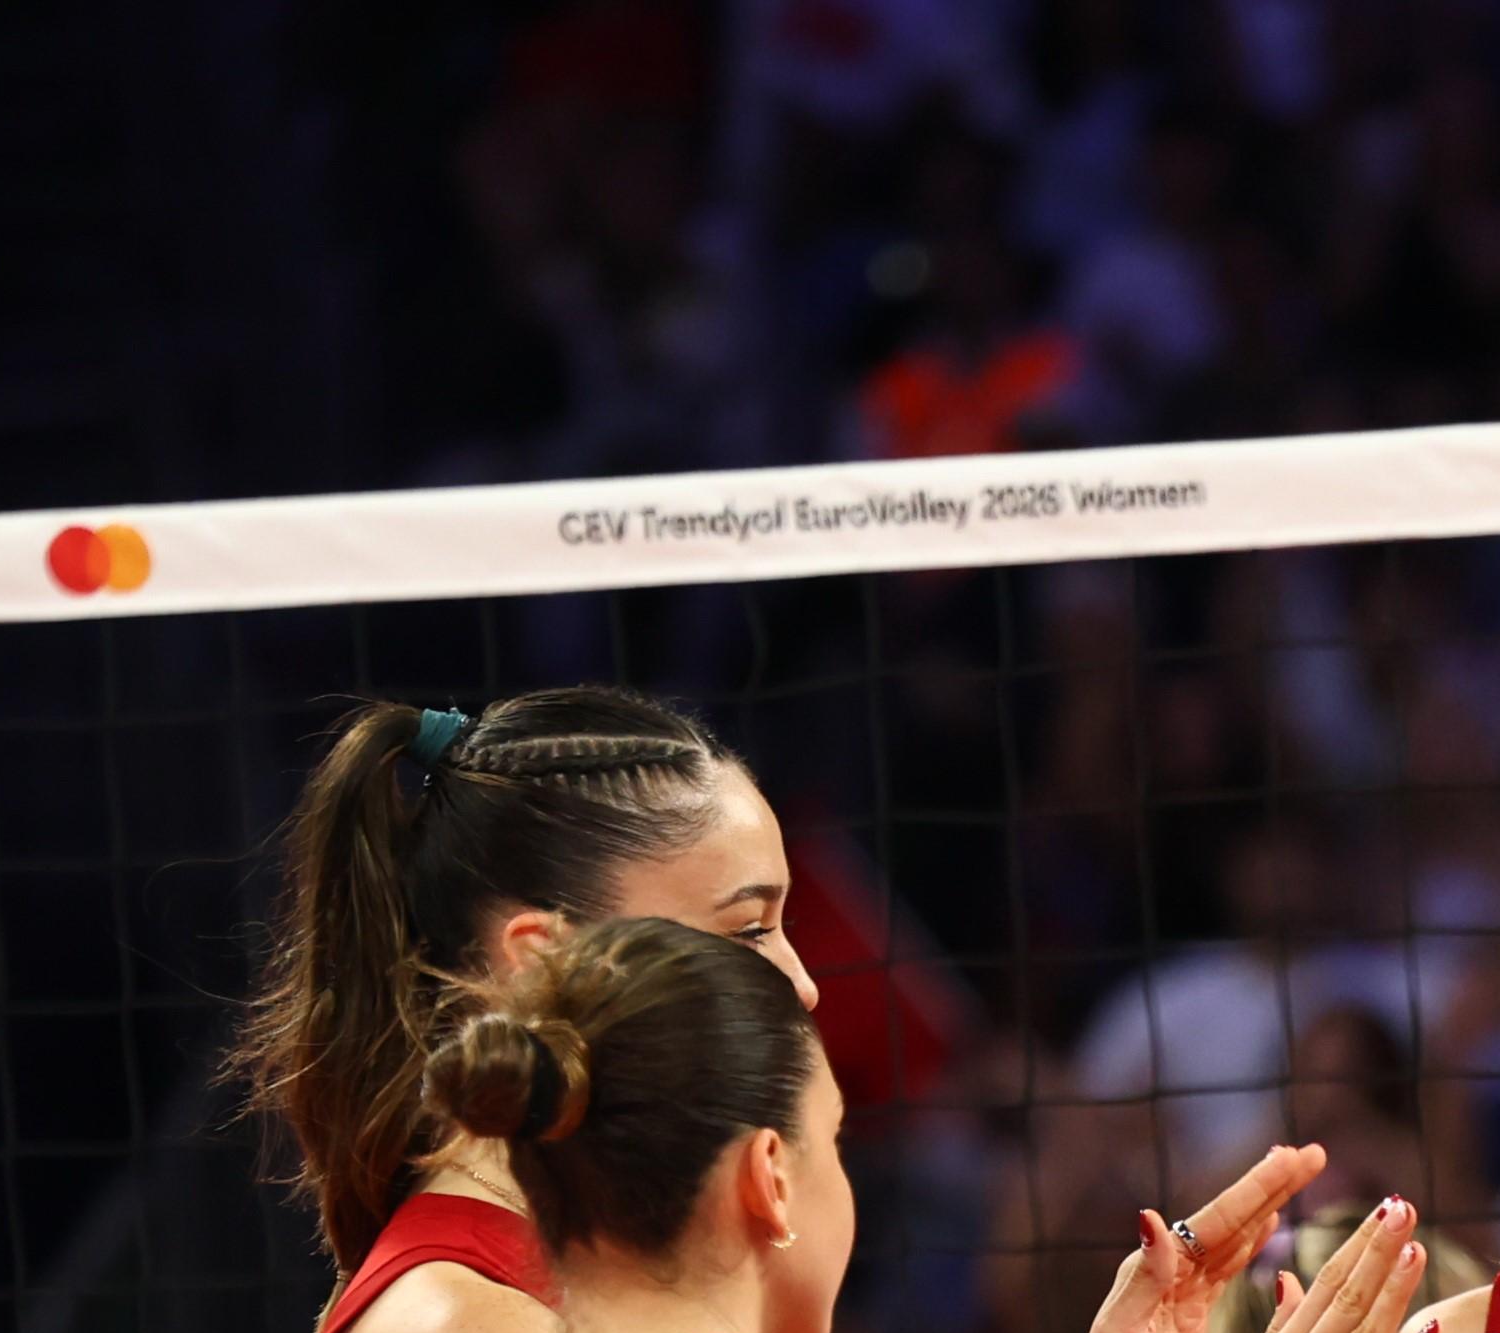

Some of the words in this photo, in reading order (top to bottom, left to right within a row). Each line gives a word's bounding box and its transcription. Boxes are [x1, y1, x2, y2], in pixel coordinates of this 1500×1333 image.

[558, 510, 627, 546] CEV
[641, 501, 784, 541] Trendyol
[795, 488, 969, 531] EuroVolley
[981, 483, 1062, 519] 2026
[1072, 476, 1206, 513] Women
